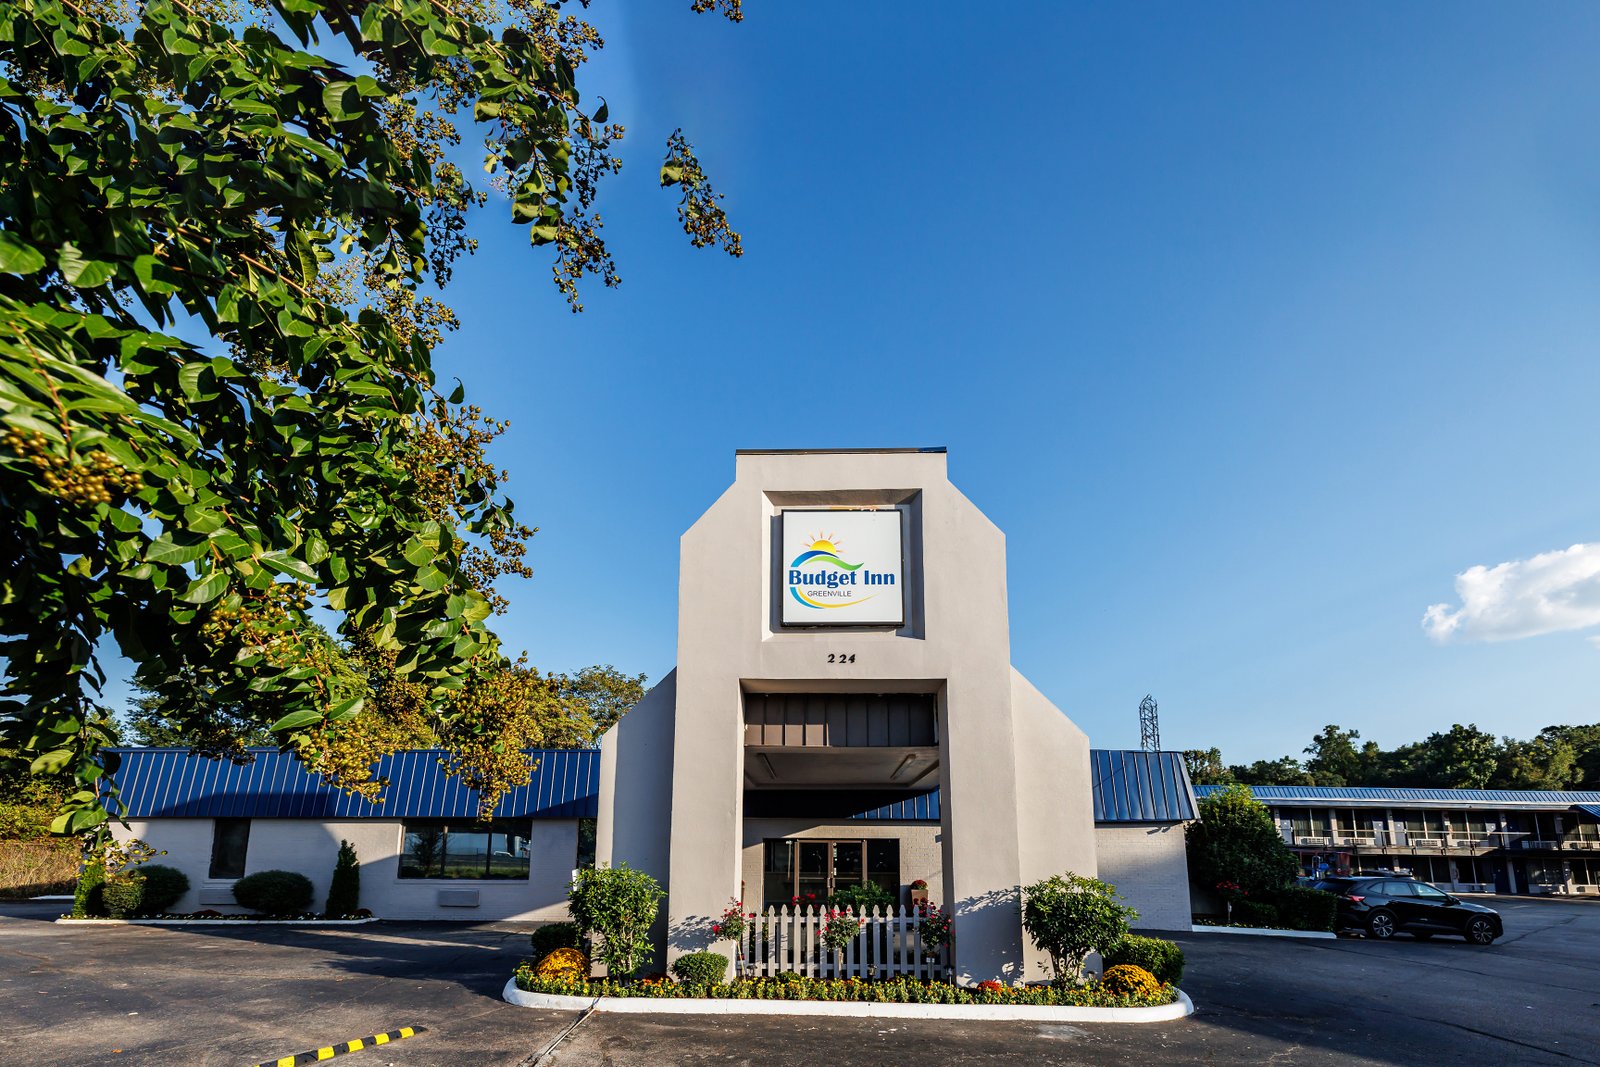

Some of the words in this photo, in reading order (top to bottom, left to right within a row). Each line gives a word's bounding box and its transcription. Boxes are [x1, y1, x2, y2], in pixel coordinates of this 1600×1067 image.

[789, 570, 857, 588] Budget
[864, 570, 895, 585] Inn
[827, 653, 856, 664] 224
